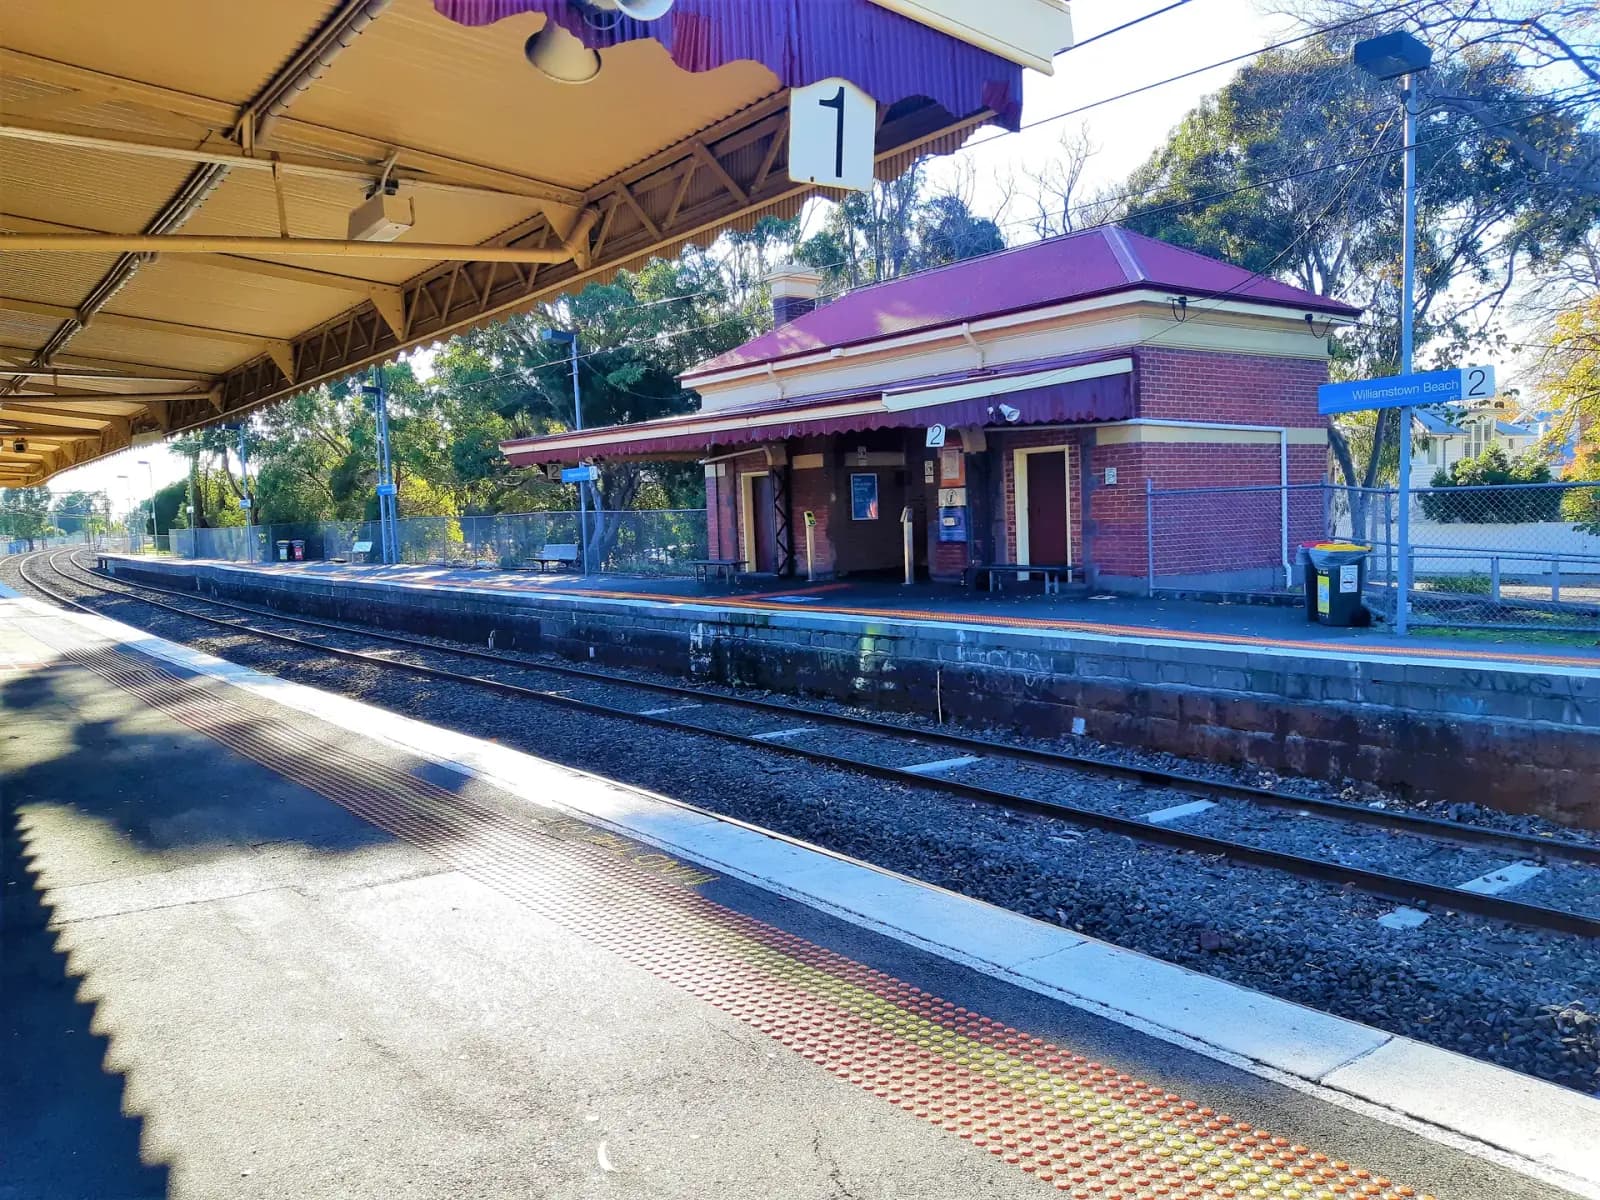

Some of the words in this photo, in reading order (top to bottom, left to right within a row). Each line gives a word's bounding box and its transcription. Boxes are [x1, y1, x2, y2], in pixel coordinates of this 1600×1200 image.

[819, 86, 844, 178] 1
[1352, 386, 1420, 401] Williamstown
[1423, 380, 1459, 393] Beach
[1469, 370, 1486, 396] 2
[930, 425, 942, 445] 2
[551, 465, 560, 478] 2
[631, 855, 720, 885] MIND
